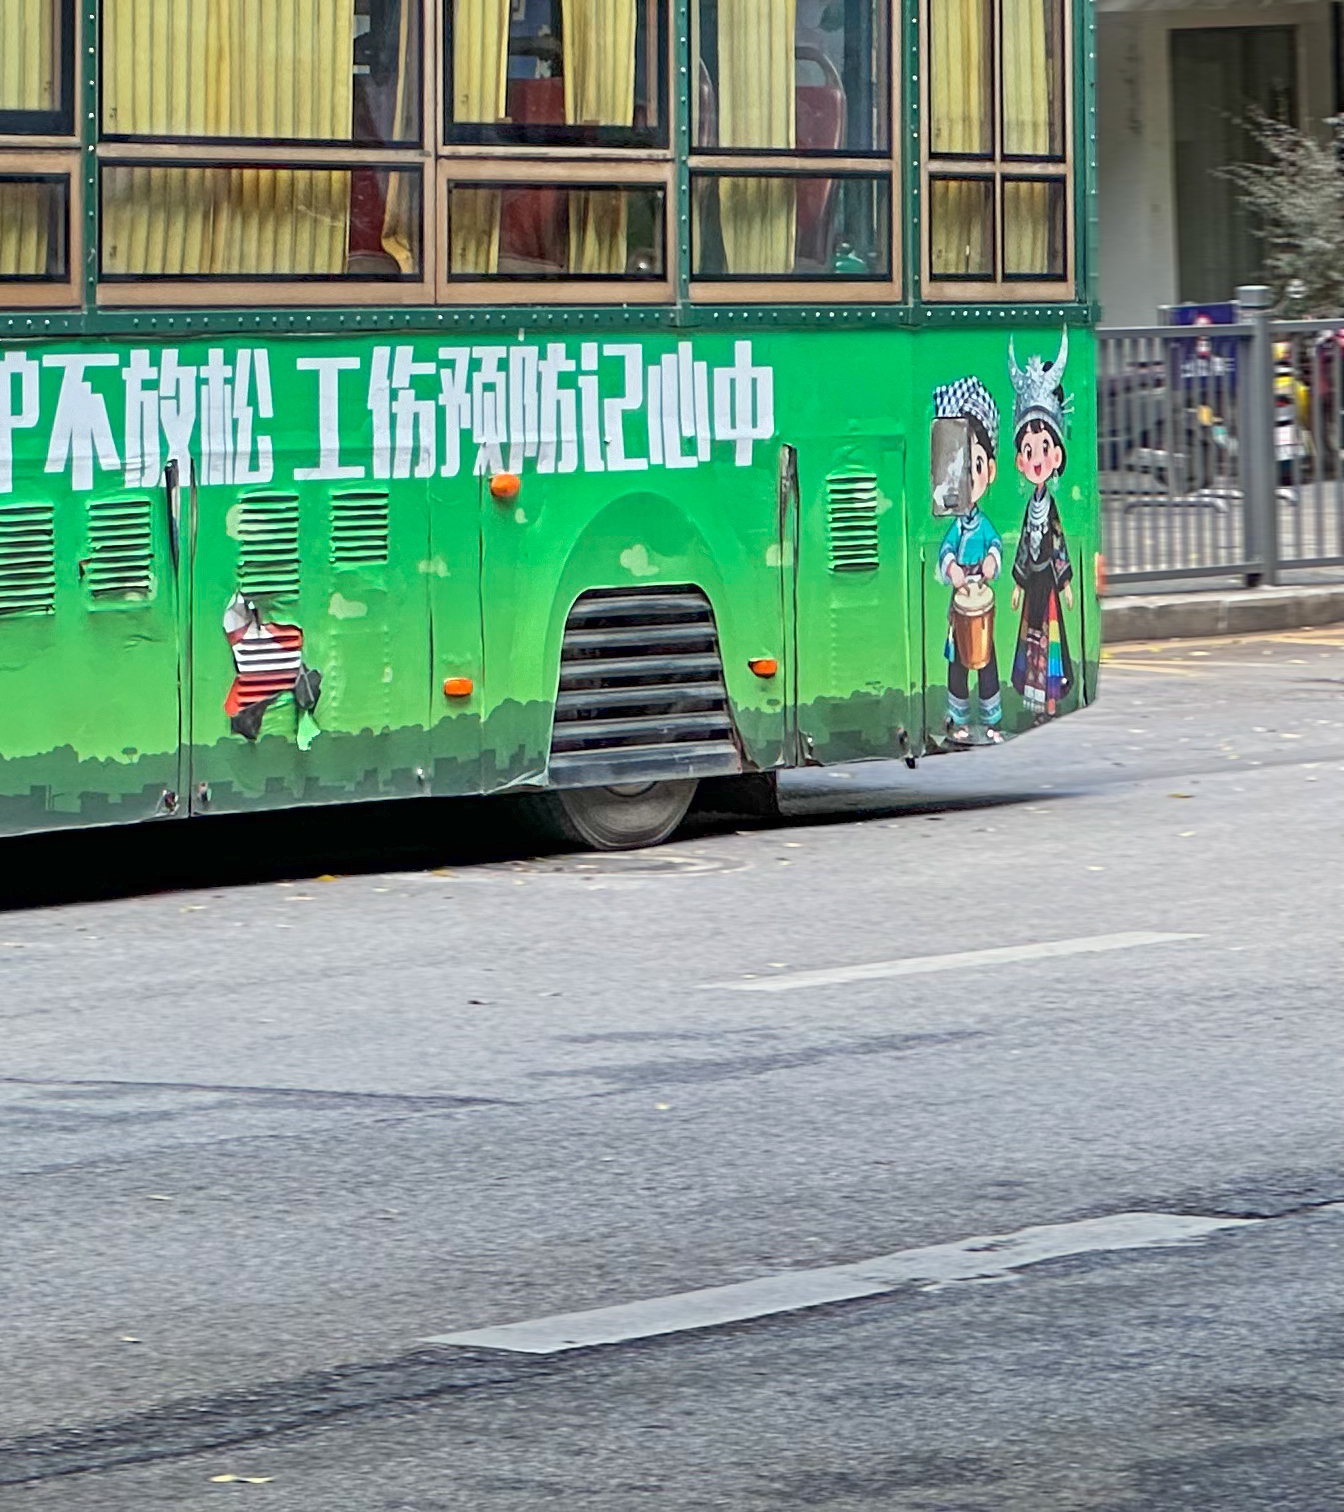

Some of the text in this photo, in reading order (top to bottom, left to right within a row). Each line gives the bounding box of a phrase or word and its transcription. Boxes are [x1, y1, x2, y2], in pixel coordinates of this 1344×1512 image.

[293, 341, 775, 480] 工伤预防记心中
